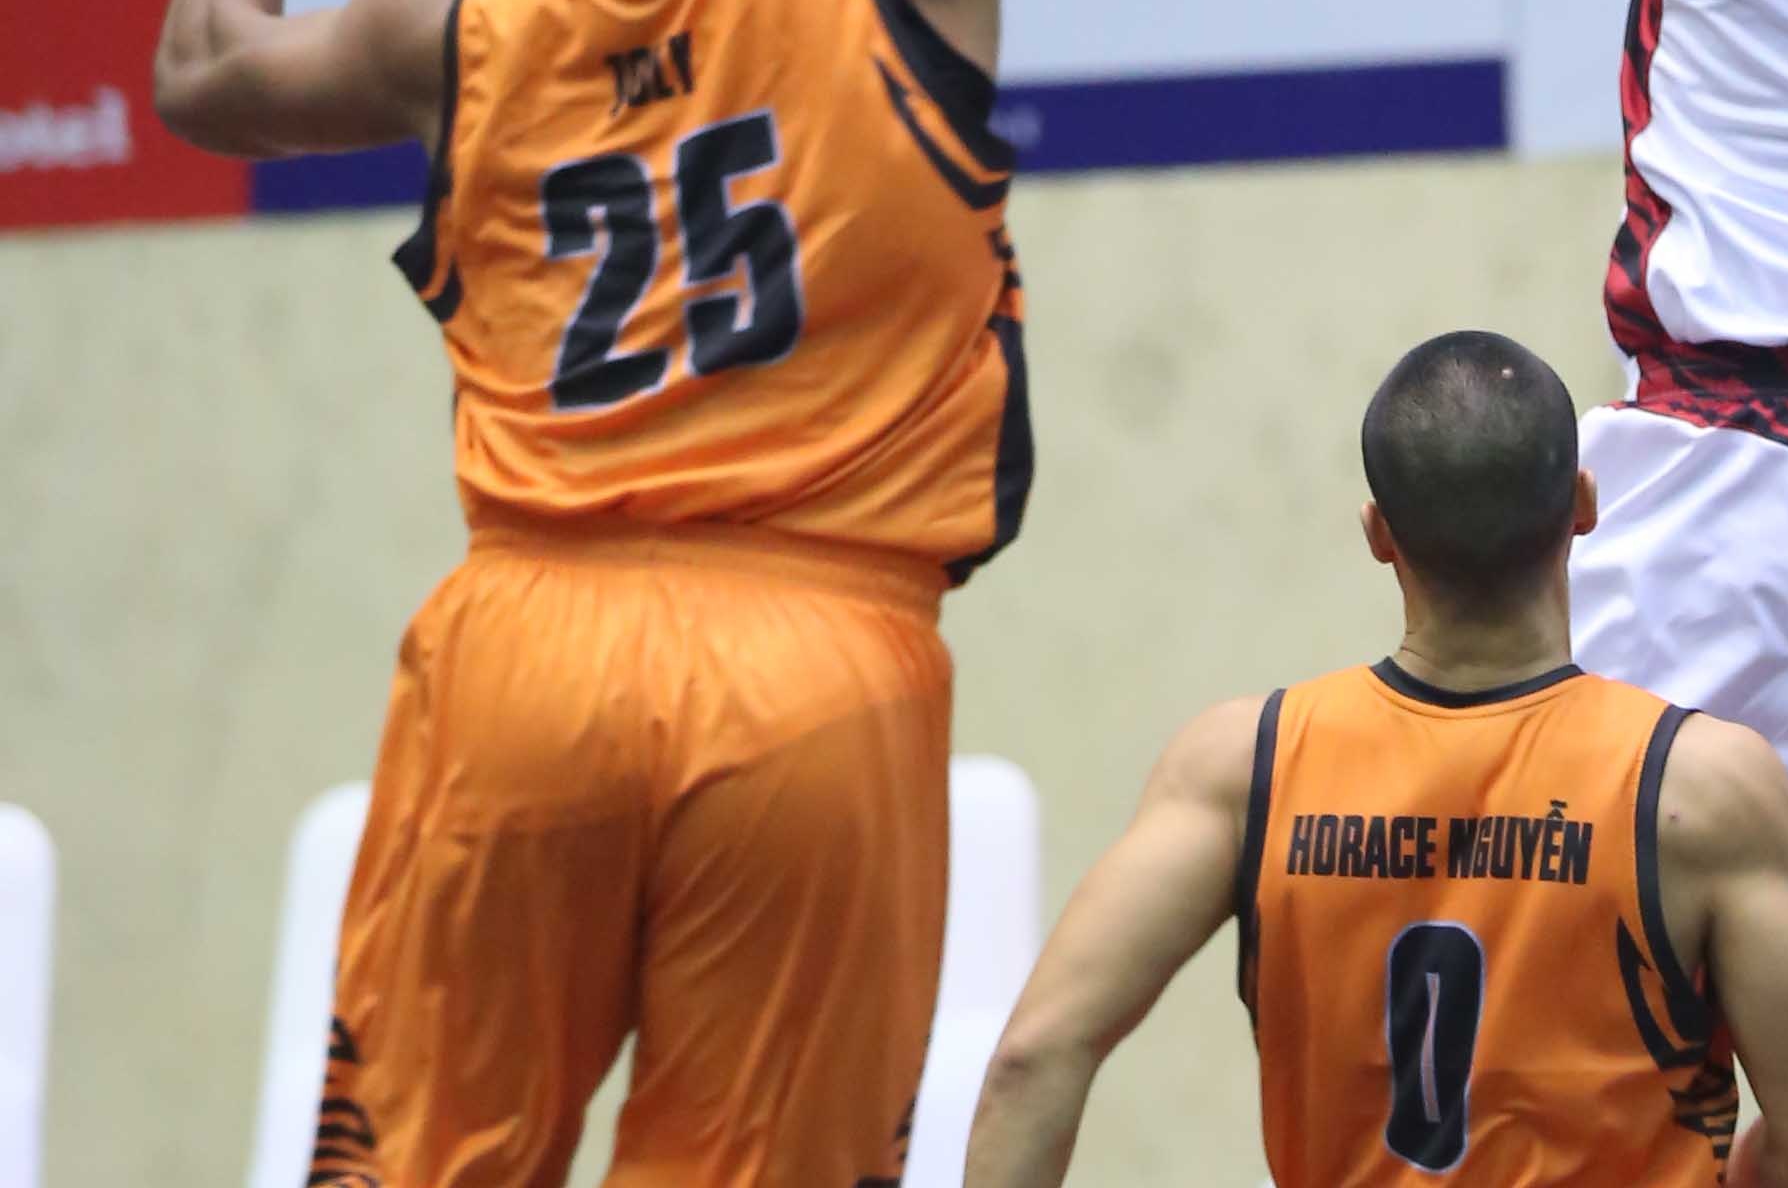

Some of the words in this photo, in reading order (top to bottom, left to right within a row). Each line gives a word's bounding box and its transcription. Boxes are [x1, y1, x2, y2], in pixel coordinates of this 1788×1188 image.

[540, 107, 805, 412] 25
[1286, 813, 1438, 880] HORACE
[1385, 920, 1485, 1175] 0
